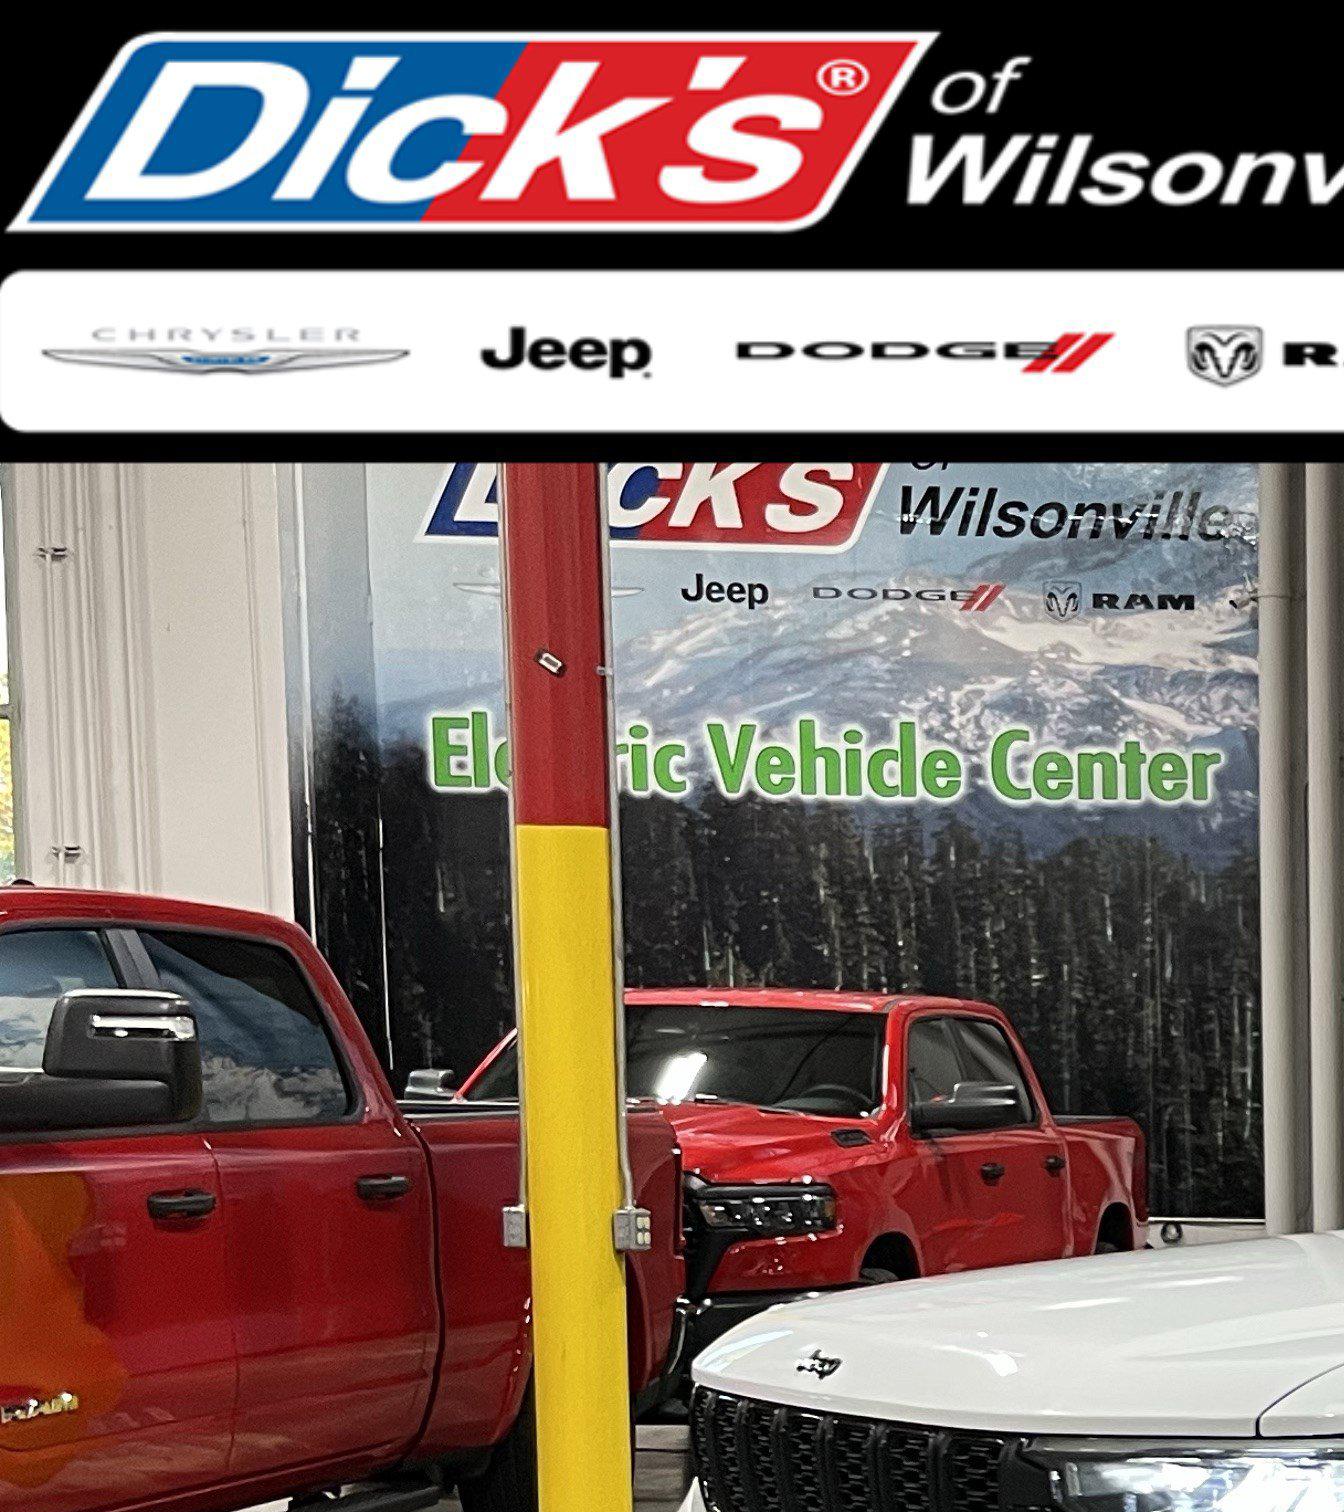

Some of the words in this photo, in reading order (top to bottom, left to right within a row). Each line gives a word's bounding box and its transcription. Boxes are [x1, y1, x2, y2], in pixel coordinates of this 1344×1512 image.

[899, 485, 1229, 541] Wilsonville
[681, 573, 769, 610] Jeep
[812, 585, 982, 602] DODGE
[1092, 593, 1196, 611] RAM
[706, 718, 962, 800] Vehicle
[990, 728, 1222, 801] Center
